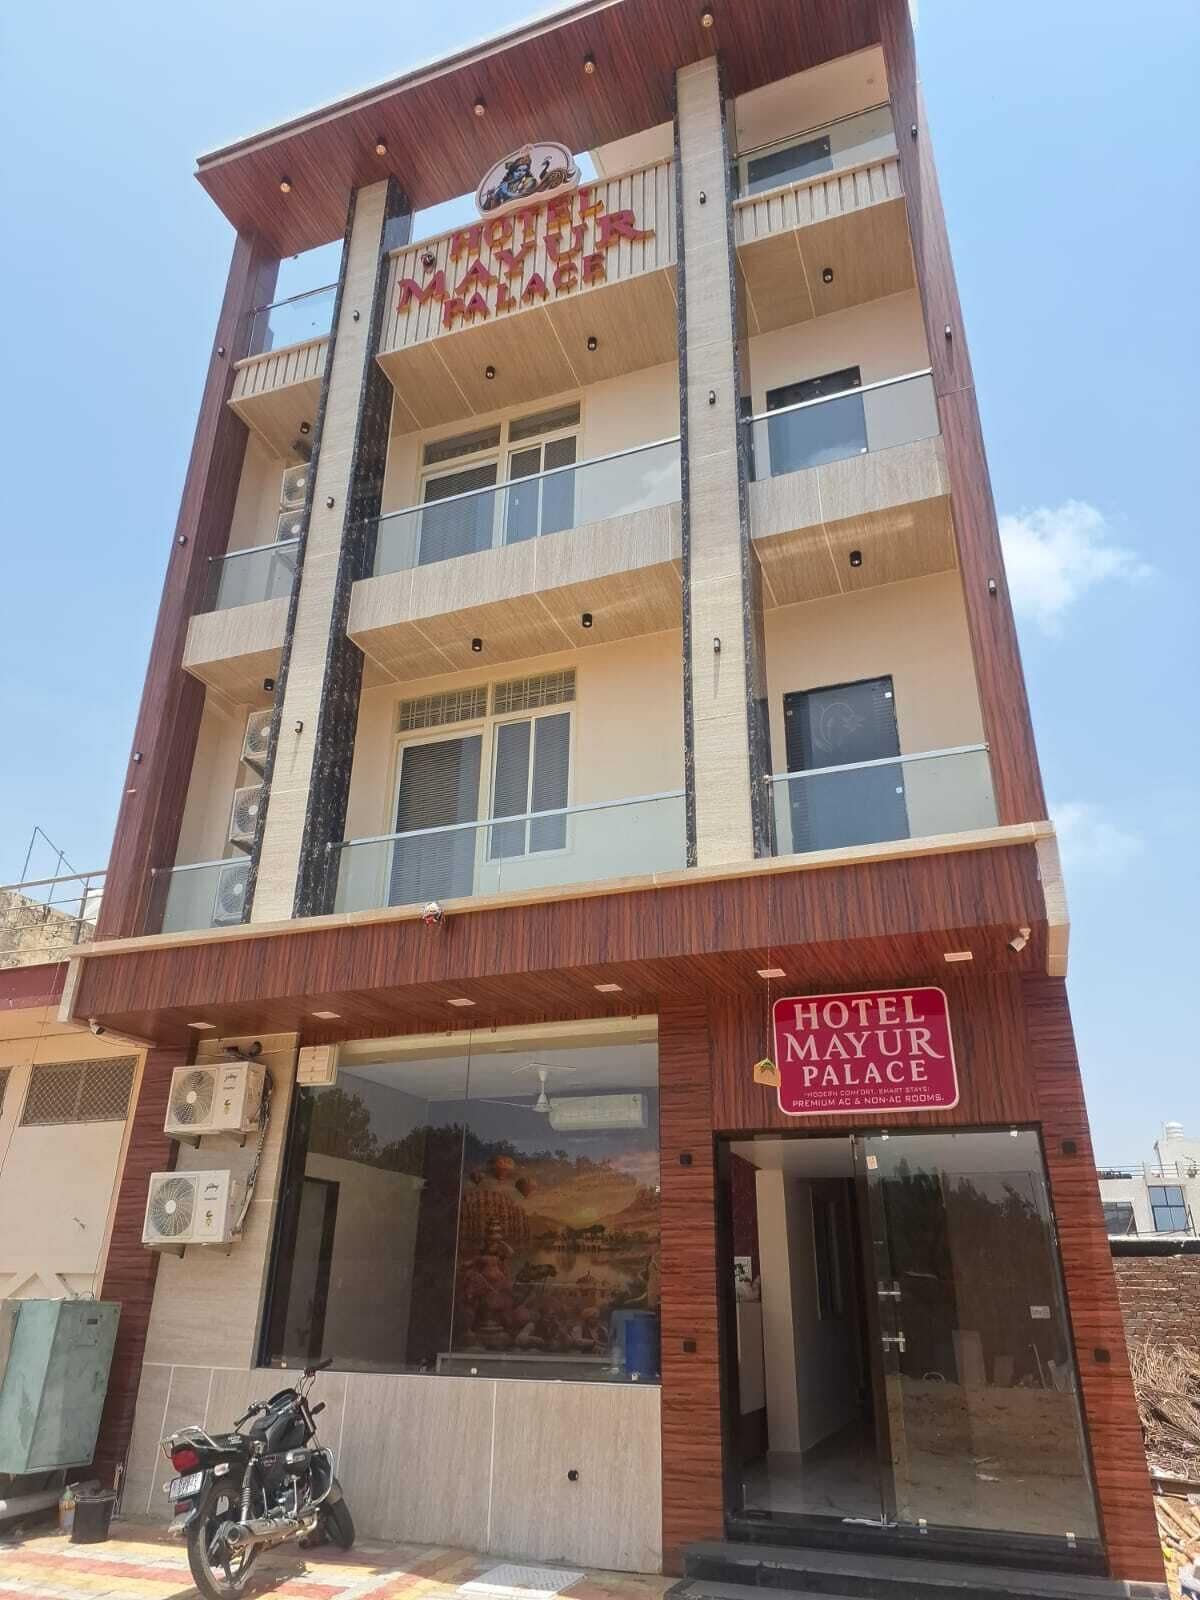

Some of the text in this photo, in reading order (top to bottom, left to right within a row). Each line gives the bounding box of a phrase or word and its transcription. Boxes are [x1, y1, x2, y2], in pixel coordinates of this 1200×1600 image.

[450, 188, 605, 263] HOTEL
[397, 208, 656, 315] MAYUR
[442, 253, 606, 329] PALACE
[793, 995, 925, 1031] HOTEL
[783, 1027, 945, 1062] MAYUR
[802, 1059, 928, 1087] PALACE
[792, 1099, 835, 1107] PREMIUM
[854, 1097, 861, 1105] &
[864, 1096, 902, 1105] NON-AC
